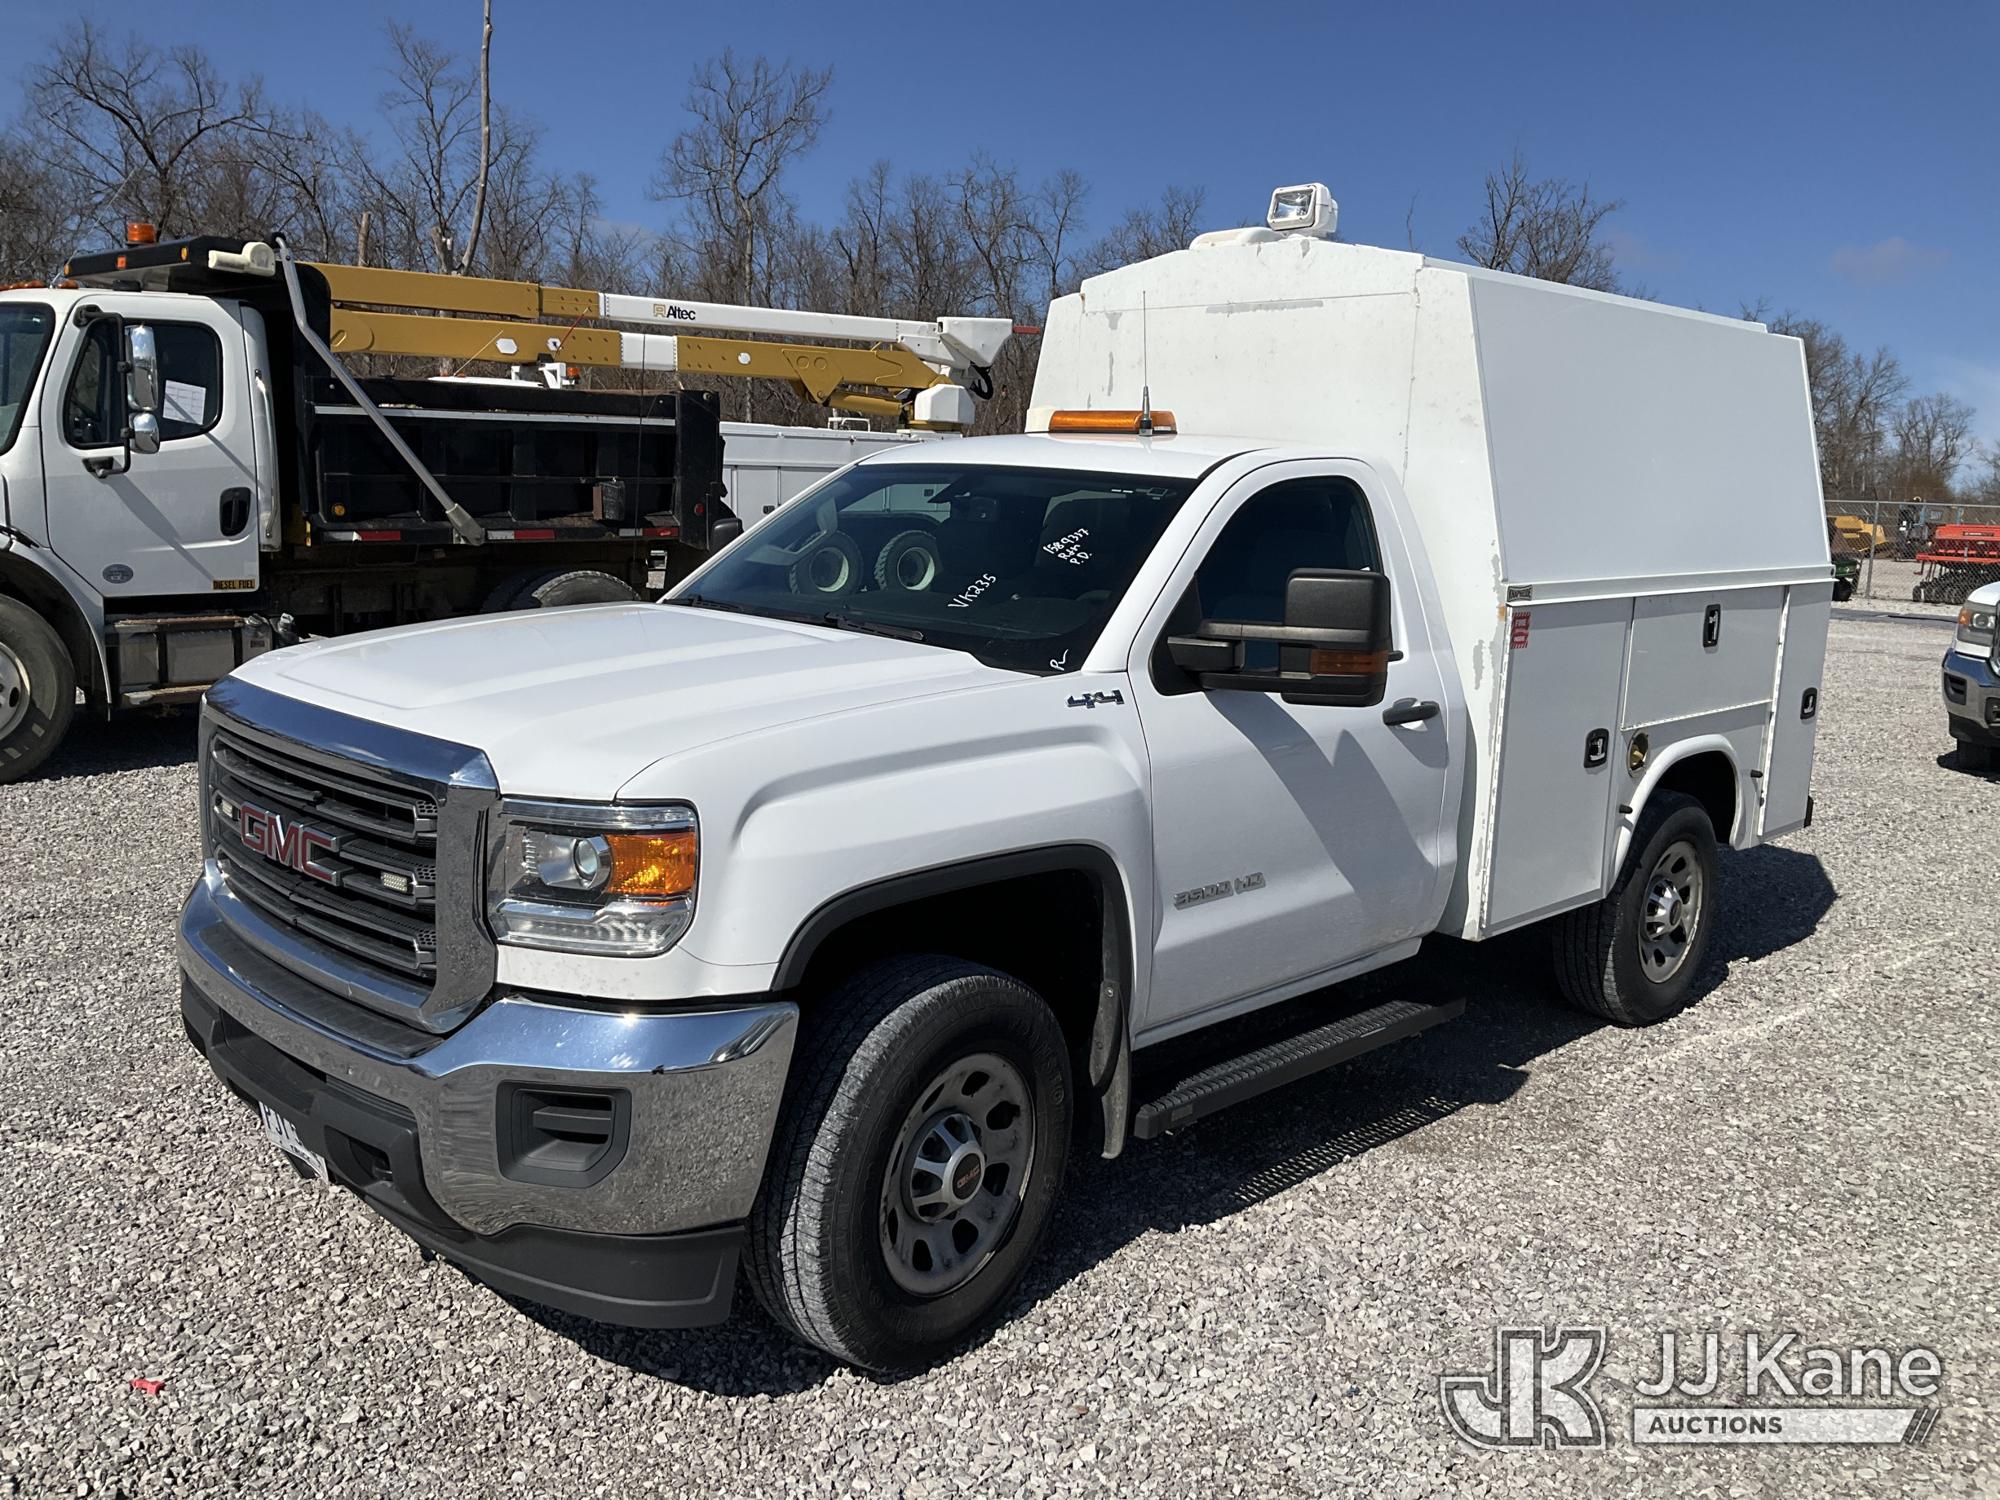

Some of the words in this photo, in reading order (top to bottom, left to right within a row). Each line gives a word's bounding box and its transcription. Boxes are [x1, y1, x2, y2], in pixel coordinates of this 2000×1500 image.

[666, 305, 696, 320] Altec
[213, 580, 236, 589] DIESEL
[239, 579, 254, 589] FUEL
[240, 802, 341, 886] GMC
[1234, 872, 1266, 894] HD
[956, 1163, 980, 1189] GMC
